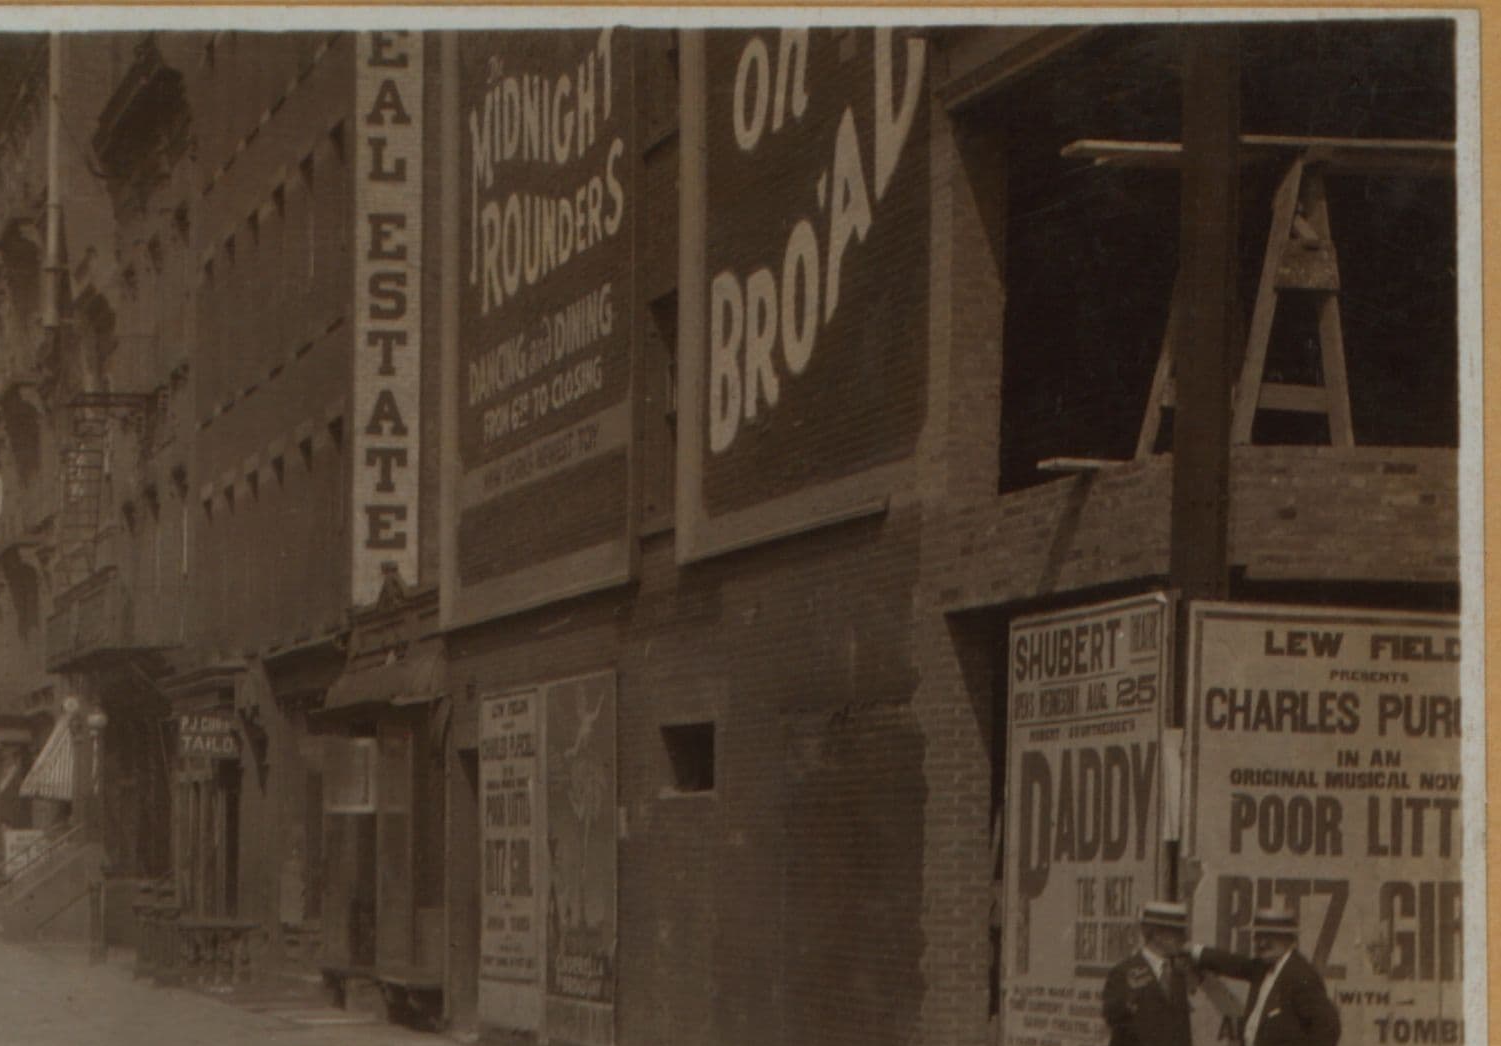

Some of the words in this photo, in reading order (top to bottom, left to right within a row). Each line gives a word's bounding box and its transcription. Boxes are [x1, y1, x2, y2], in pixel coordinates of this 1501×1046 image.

[469, 27, 614, 190] MIDNIGHT
[480, 136, 625, 316] ROUNDERS
[468, 332, 527, 407] DANCING
[554, 282, 613, 361] DINING
[365, 212, 409, 551] ESTATE
[531, 383, 549, 422] TO
[551, 355, 603, 410] CLOSING
[1014, 618, 1122, 684] SHUBERT
[1264, 630, 1343, 658] LEW
[1115, 673, 1158, 707] 25
[1205, 686, 1360, 733] CHARLES
[1229, 768, 1318, 789] ORIGINAL
[1325, 769, 1410, 791] MUSICAL
[1337, 750, 1359, 767] IN
[1370, 750, 1401, 767] AN
[1229, 793, 1344, 857] POOR
[1016, 740, 1158, 975] PADDY
[1338, 991, 1391, 1006] WITH
[1373, 1018, 1464, 1045] TOMB
